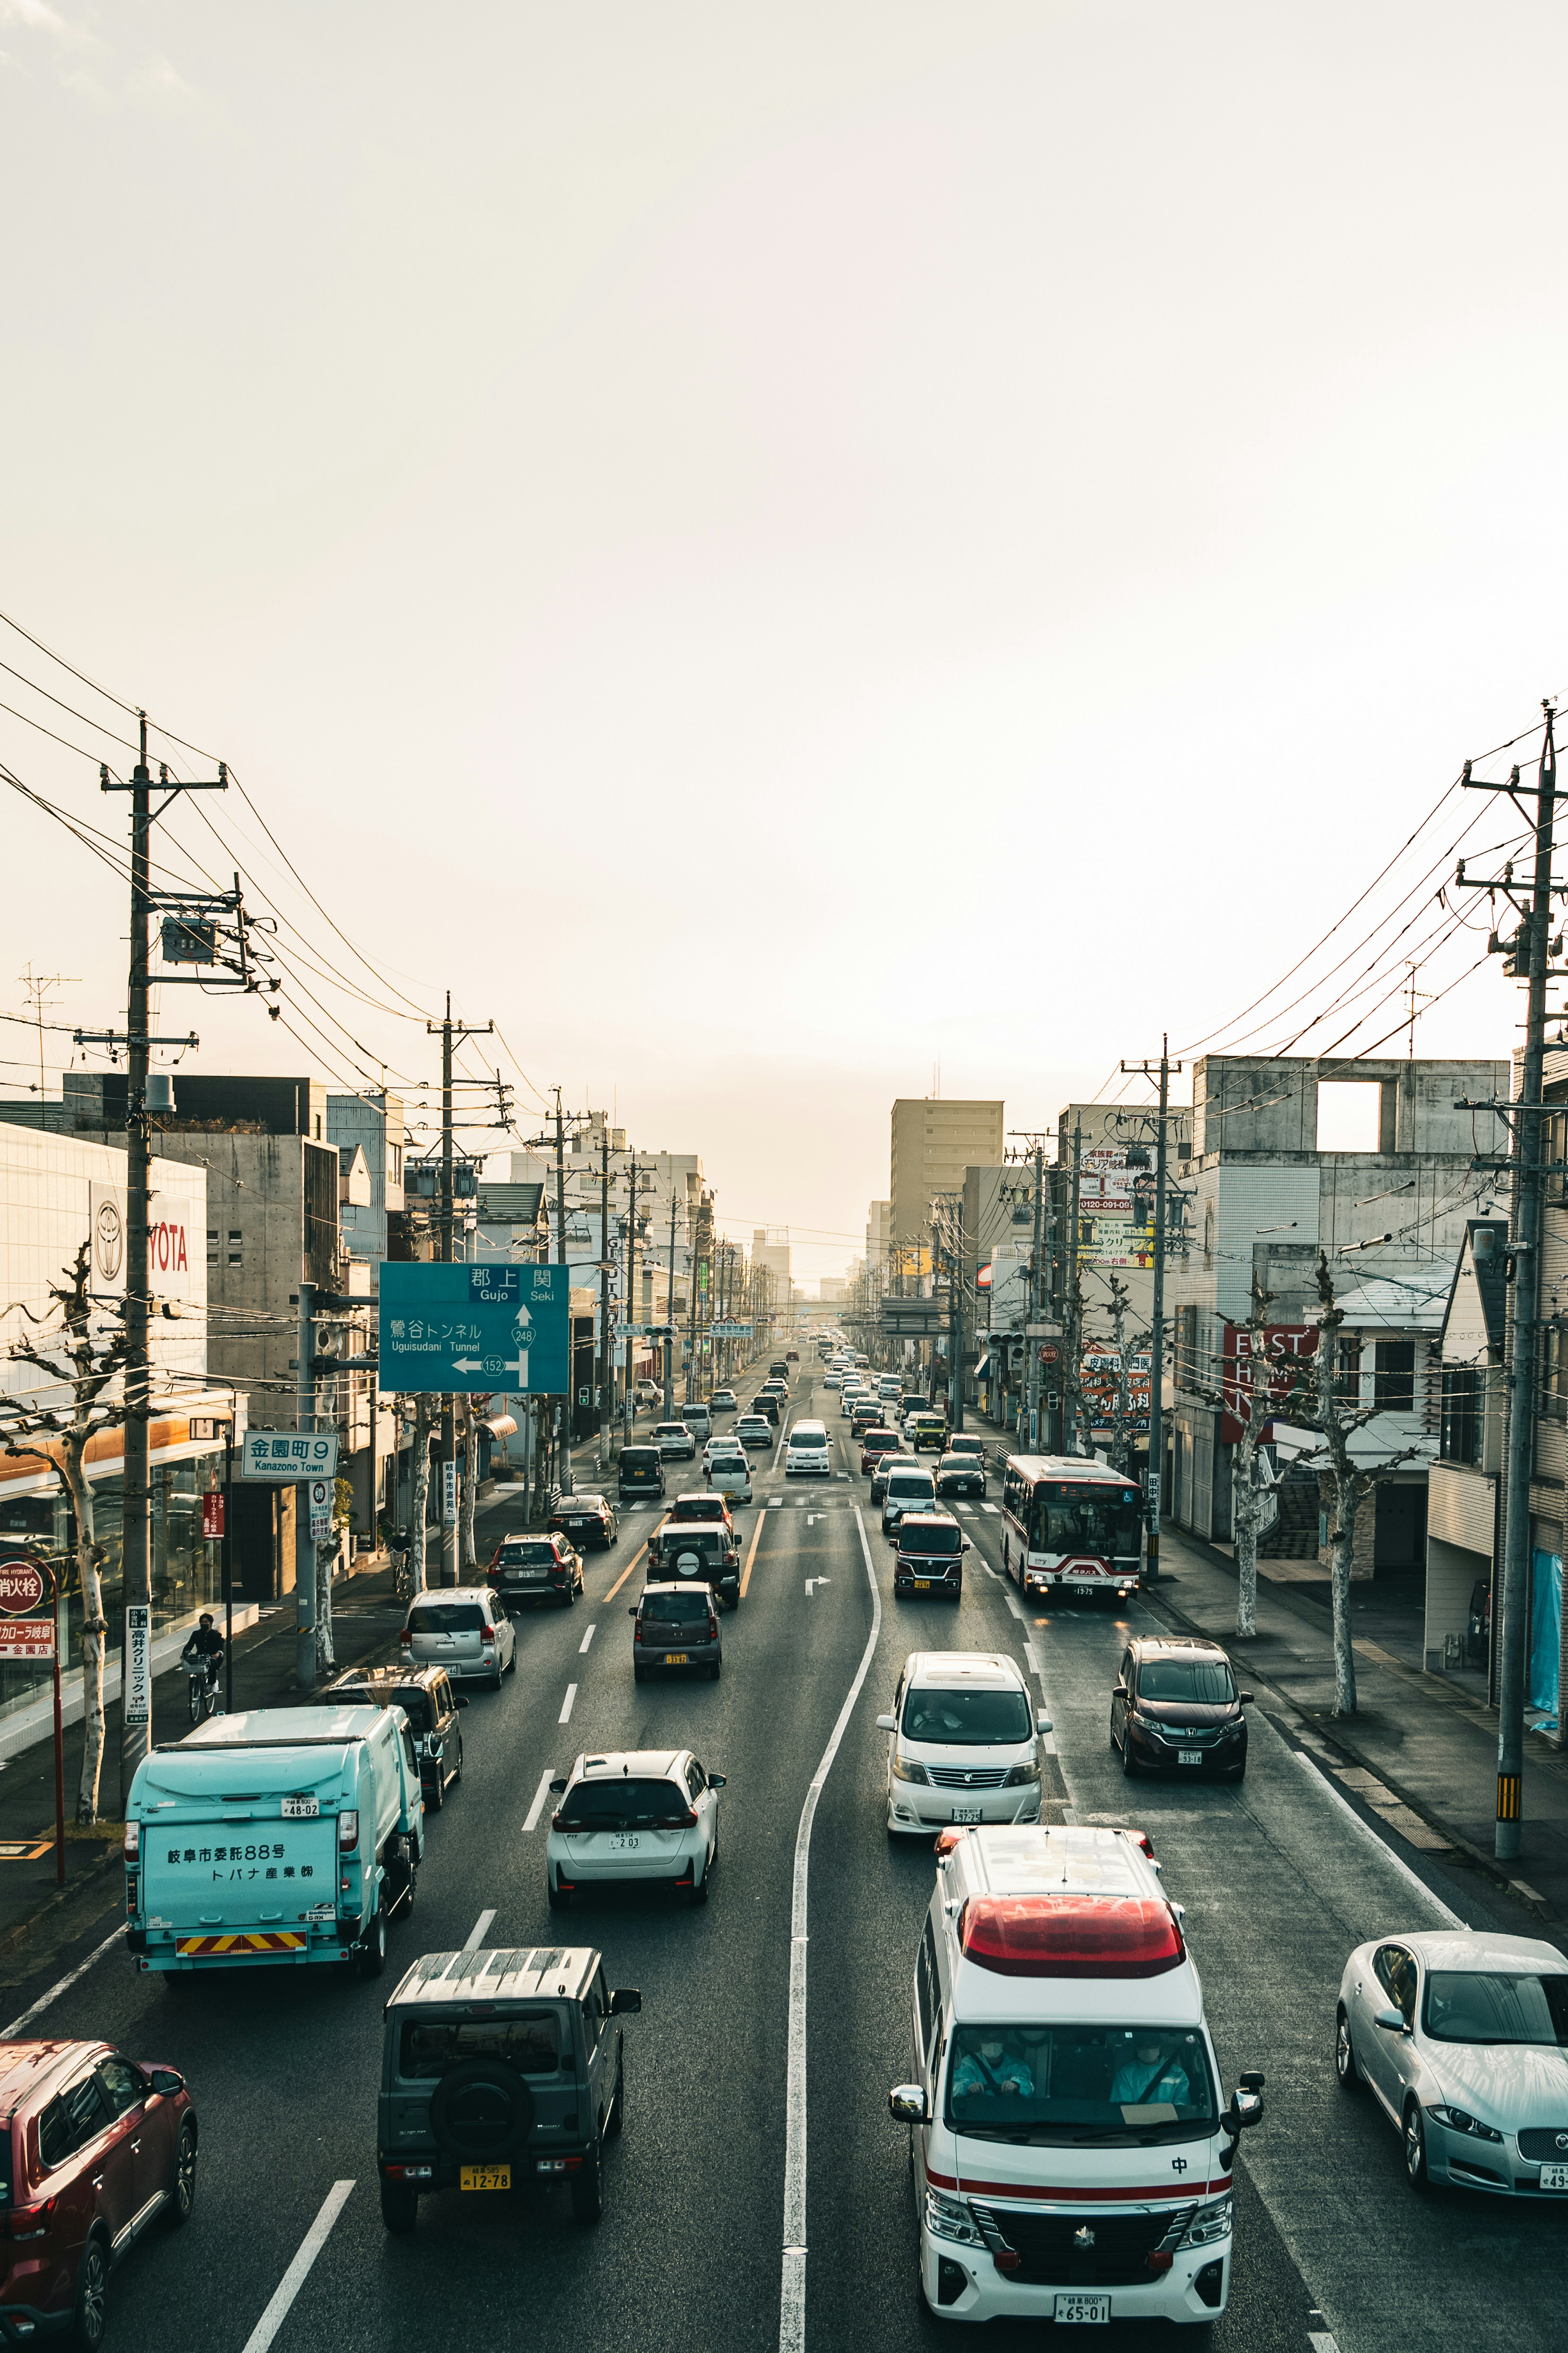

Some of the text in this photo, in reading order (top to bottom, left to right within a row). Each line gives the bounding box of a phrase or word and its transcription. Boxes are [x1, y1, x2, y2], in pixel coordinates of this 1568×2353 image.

[126, 1219, 187, 1271] YOTA
[471, 1269, 517, 1287] 郡上
[534, 1270, 551, 1287] 関
[480, 1290, 508, 1302] Gujo
[530, 1291, 554, 1301] Seki
[390, 1320, 482, 1339] 鶯谷トンネル
[516, 1331, 532, 1341] 248
[392, 1341, 479, 1353] Uguisudani Tunnel
[1236, 1334, 1305, 1356] EST
[485, 1361, 501, 1372] 152
[1091, 1357, 1150, 1369] 皮膚科門医
[251, 1439, 329, 1459] 金園町9
[255, 1460, 323, 1472] Kanazono Town
[445, 1463, 454, 1508] 岐阜市斎苑
[0, 1625, 51, 1639] カローラ岐阜
[13, 1645, 48, 1655] 金園店
[131, 1630, 145, 1693] 高井クリニック
[290, 1805, 317, 1815] 48-02
[168, 1844, 285, 1864] 岐阜市委託88号
[1172, 2157, 1187, 2174] 中
[474, 2175, 508, 2188] 12-78
[1067, 2306, 1105, 2321] 65-01
